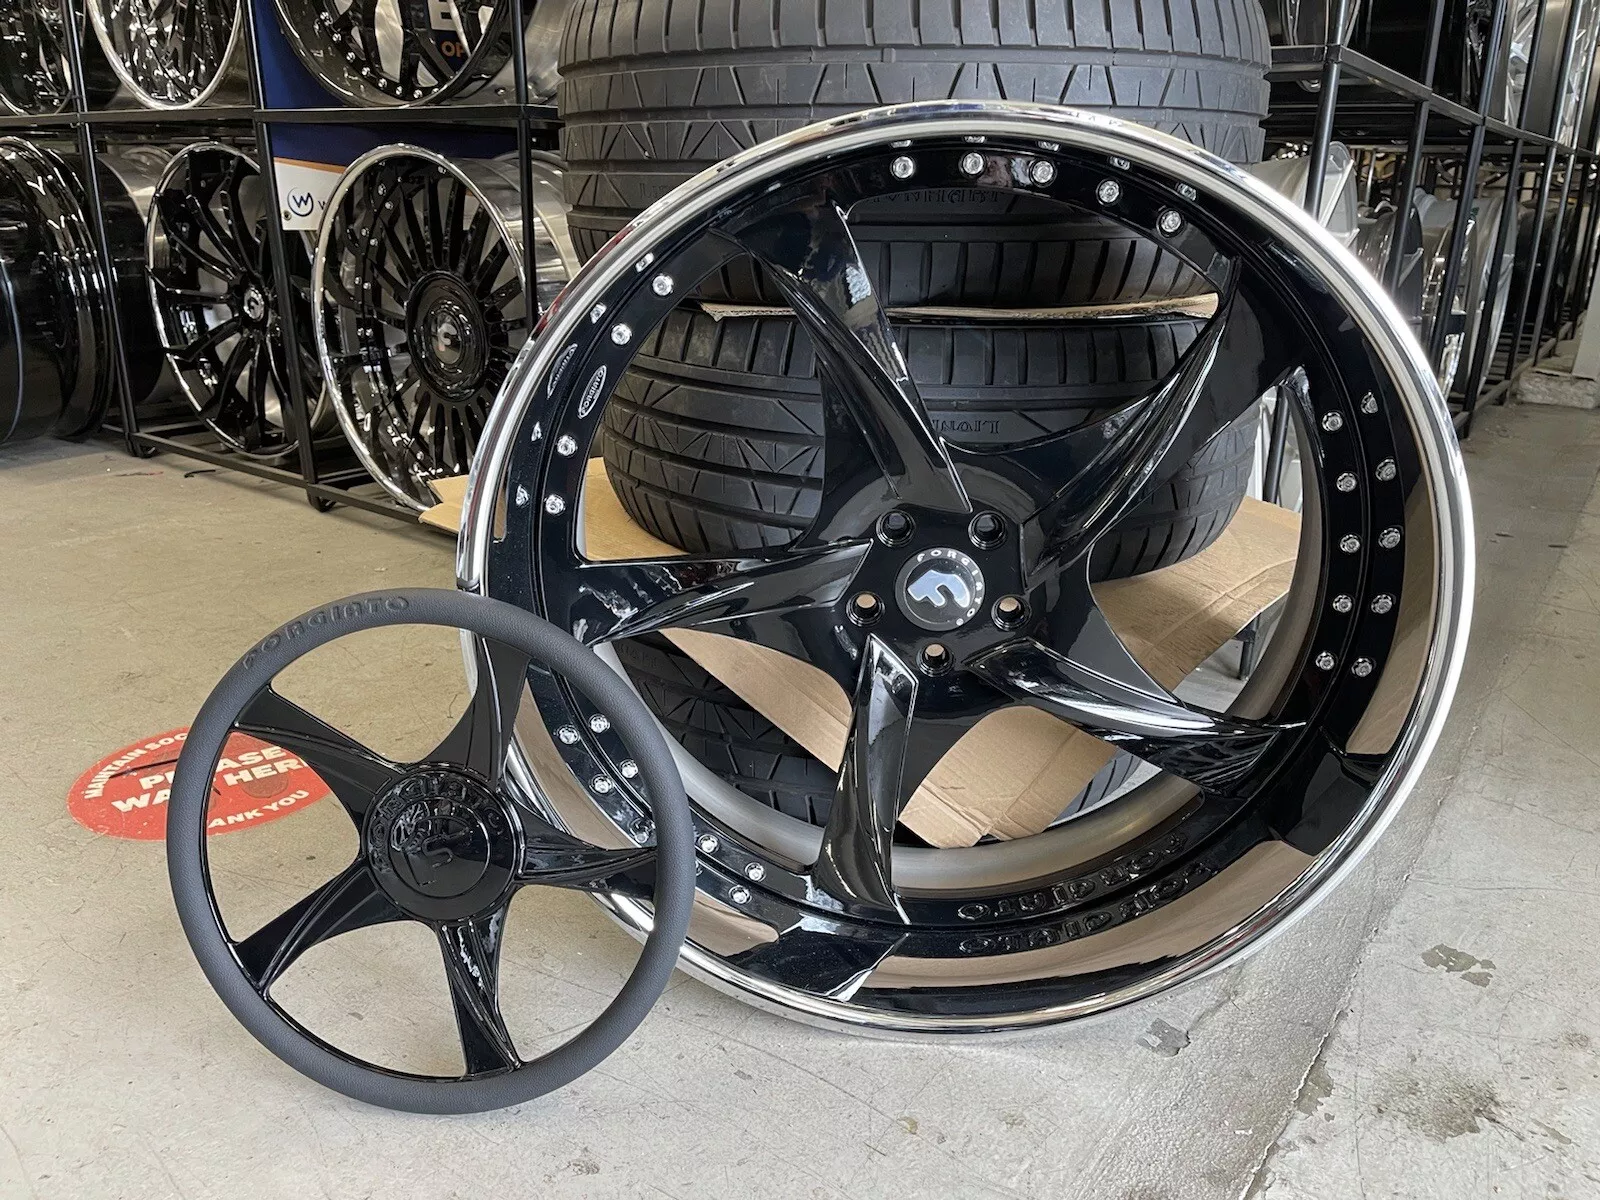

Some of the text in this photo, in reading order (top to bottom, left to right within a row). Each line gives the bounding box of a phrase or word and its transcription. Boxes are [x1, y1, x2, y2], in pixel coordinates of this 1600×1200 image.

[931, 419, 1000, 436] LION
[917, 549, 984, 619] FORGIATO
[243, 596, 409, 670] FORGIATO
[84, 733, 187, 799] MAINTAIN SOC
[139, 745, 287, 790] PASE
[223, 758, 308, 786] HER
[208, 789, 310, 829] ANK YOU
